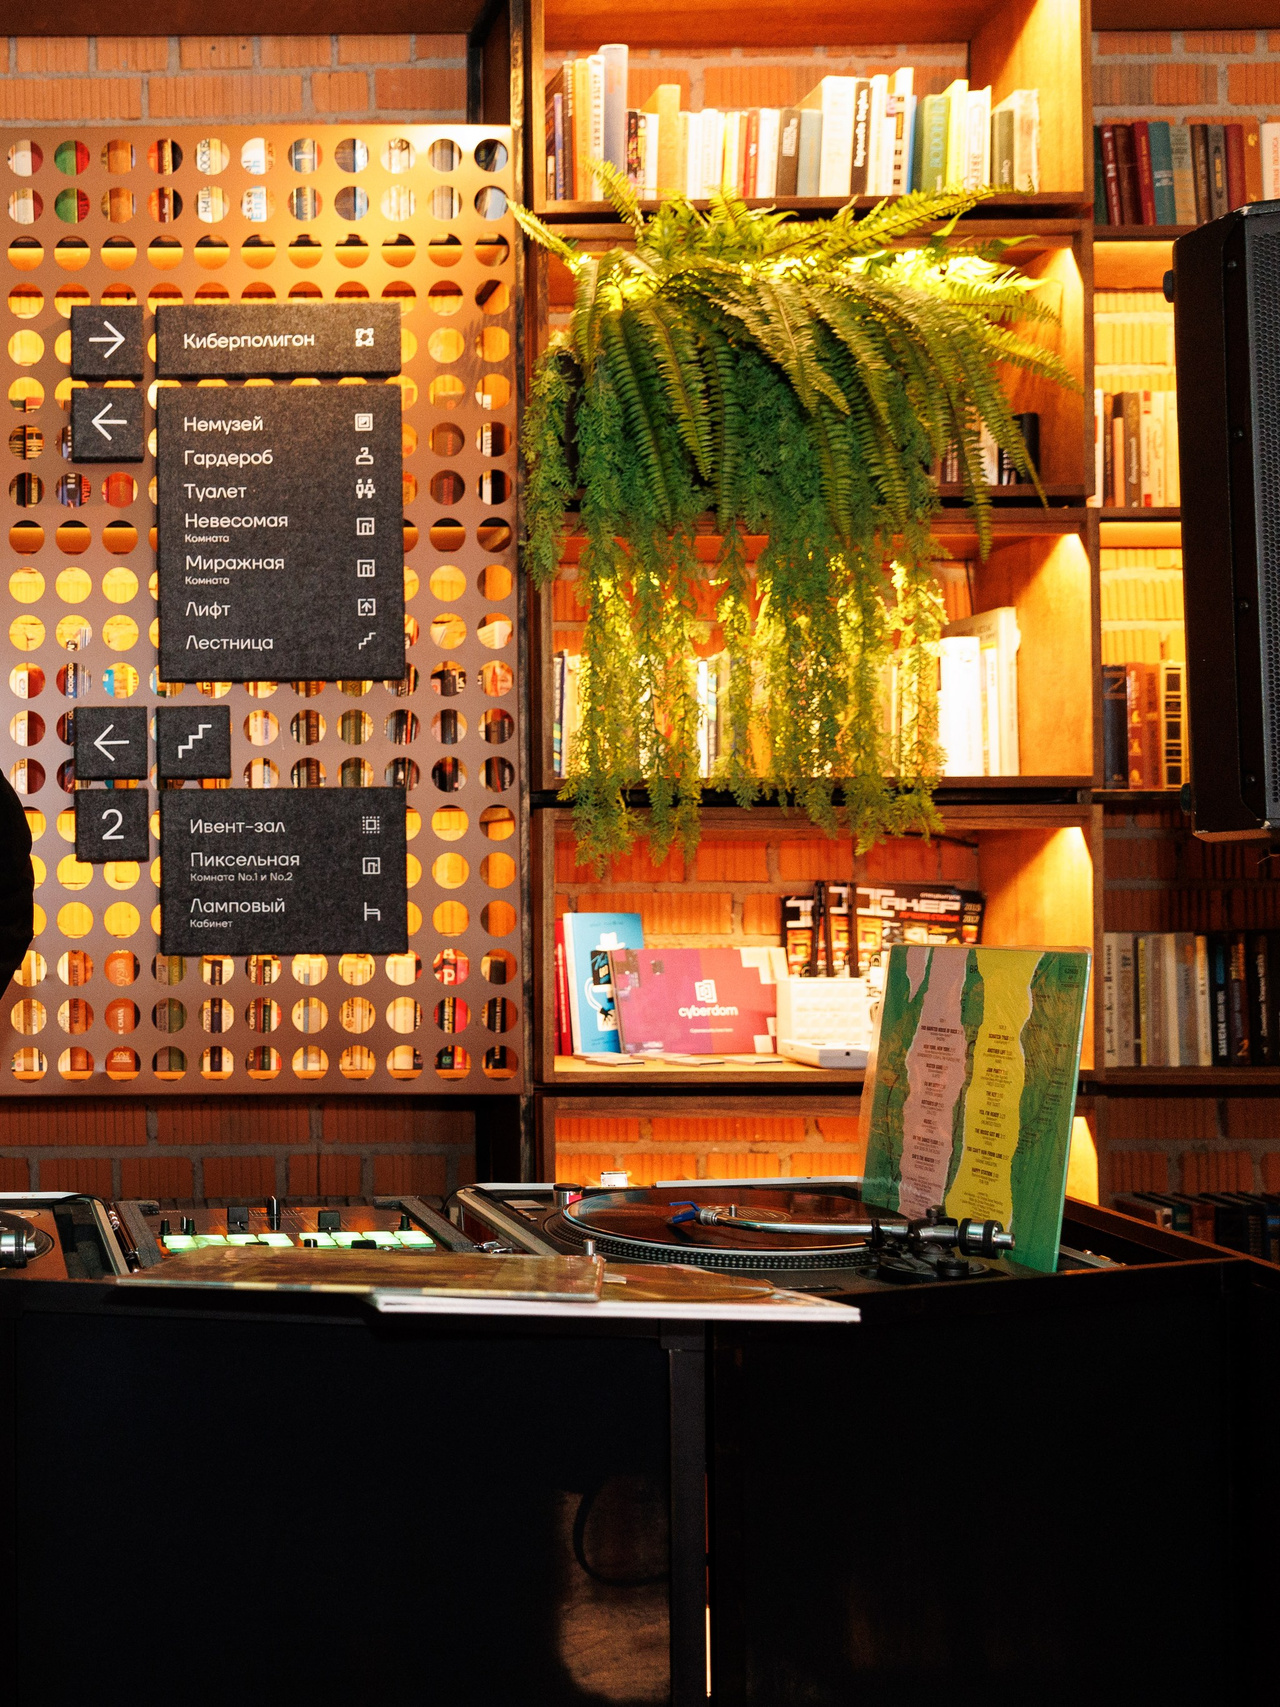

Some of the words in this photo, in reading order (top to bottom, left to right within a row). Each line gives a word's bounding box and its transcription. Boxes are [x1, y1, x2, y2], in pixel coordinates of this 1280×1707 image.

[183, 333, 315, 350] Киберполигон
[183, 415, 264, 435] Немузей
[184, 448, 274, 468] Гардероб
[184, 483, 248, 501] Туалет
[184, 513, 289, 530] Невесомая
[184, 534, 231, 543] Комната
[185, 555, 286, 574] Миражная
[184, 576, 231, 585] Комната
[185, 601, 232, 619] Лифт
[185, 634, 275, 652] Лестница
[101, 808, 124, 841] 2
[190, 819, 286, 834] Ивент-зал
[190, 851, 300, 867] Пиксельная
[190, 872, 235, 882] Комната
[238, 871, 258, 881] No.1
[270, 872, 294, 881] No.2
[190, 897, 286, 913] Ламповый
[190, 919, 233, 928] Кабинет
[678, 1004, 739, 1019] cyberdom
